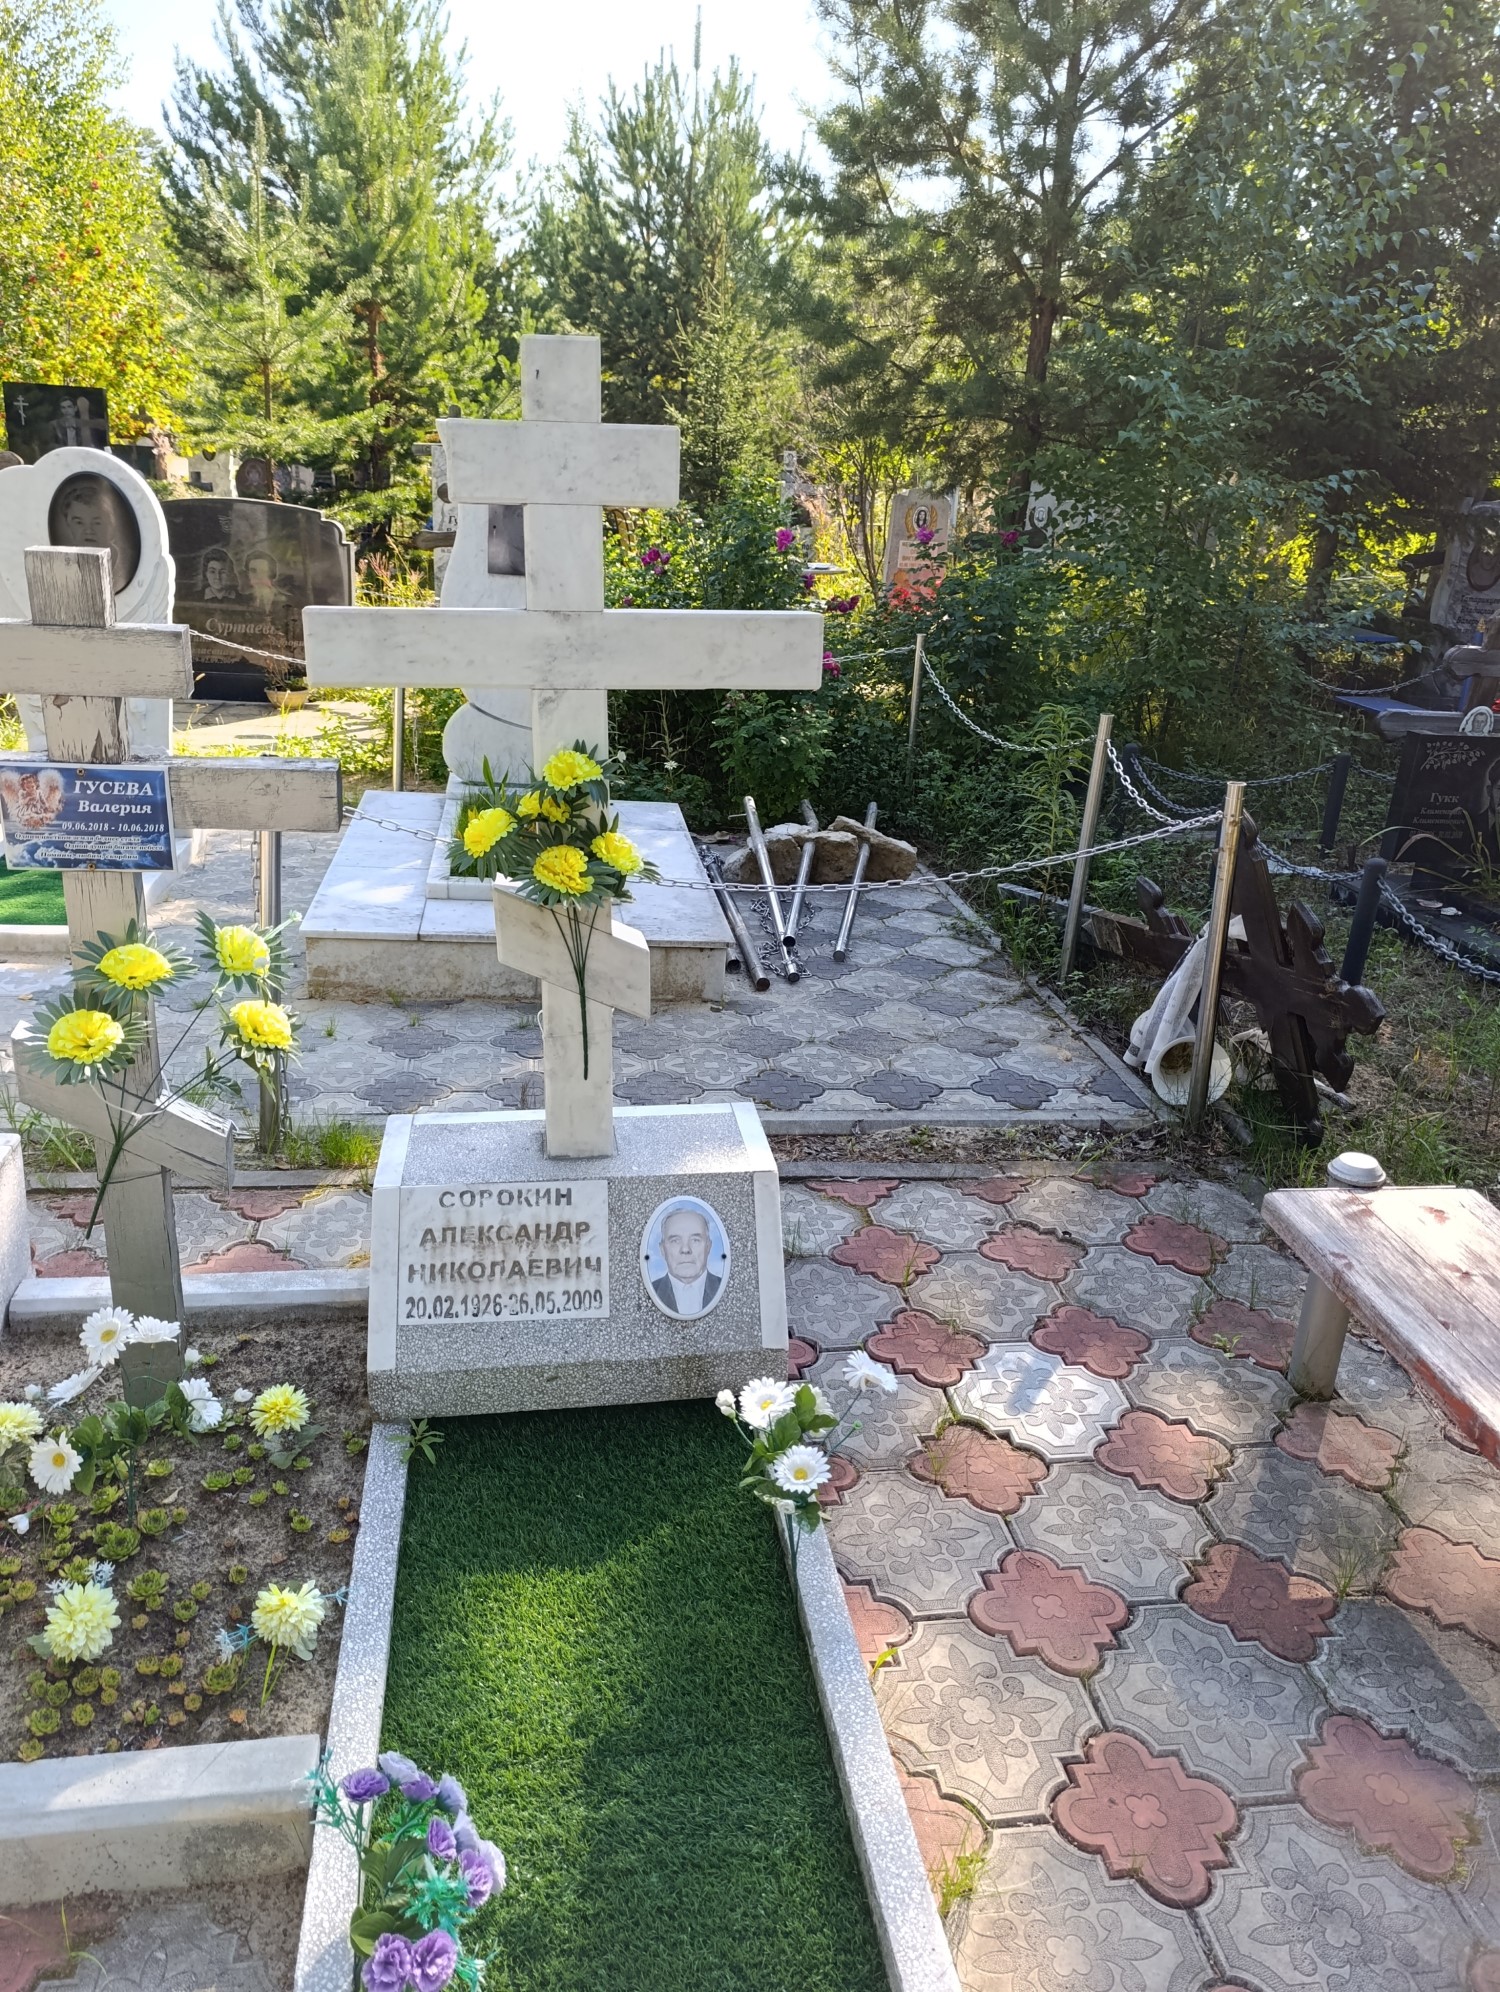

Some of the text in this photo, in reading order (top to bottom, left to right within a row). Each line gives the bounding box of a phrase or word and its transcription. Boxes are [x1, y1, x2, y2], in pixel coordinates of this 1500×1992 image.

[73, 780, 154, 796] ГУСЕВА
[1430, 792, 1460, 805] Гукк
[77, 800, 153, 816] Валерия
[62, 822, 109, 831] 09.06.2018
[118, 823, 165, 832] 10.06.2018
[438, 1187, 573, 1208] СОРОКИН
[419, 1221, 591, 1247] АЛЕКСАНДР
[407, 1256, 602, 1284] НИКОЛАЕВИЧ
[405, 1289, 603, 1319] 20.02.1926-26.05.2009
